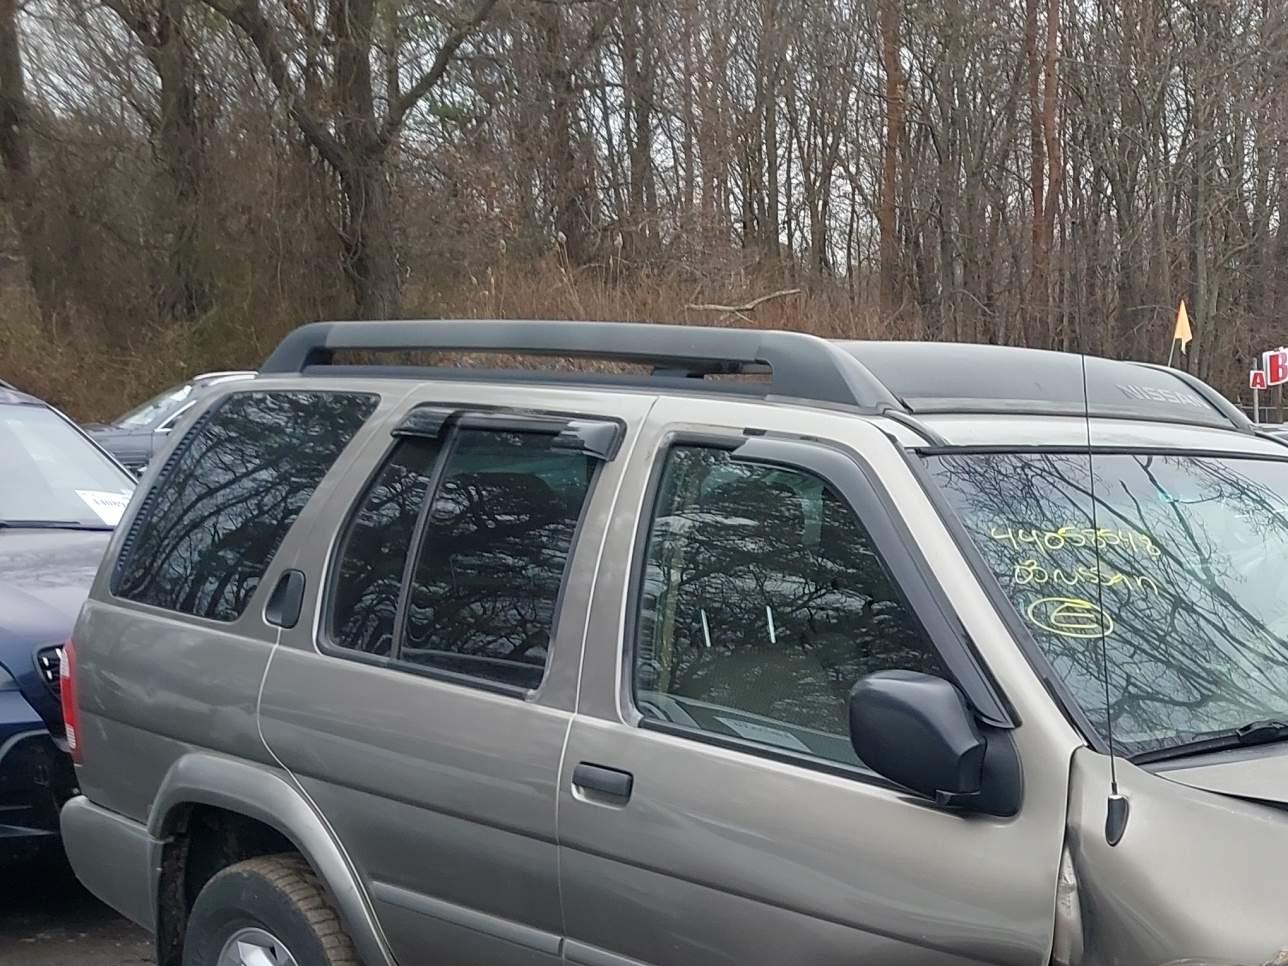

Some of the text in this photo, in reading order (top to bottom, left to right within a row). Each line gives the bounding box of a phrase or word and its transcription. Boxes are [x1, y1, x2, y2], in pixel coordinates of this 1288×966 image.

[1251, 372, 1265, 388] A
[1269, 352, 1288, 383] B
[1115, 384, 1212, 410] NISSAN
